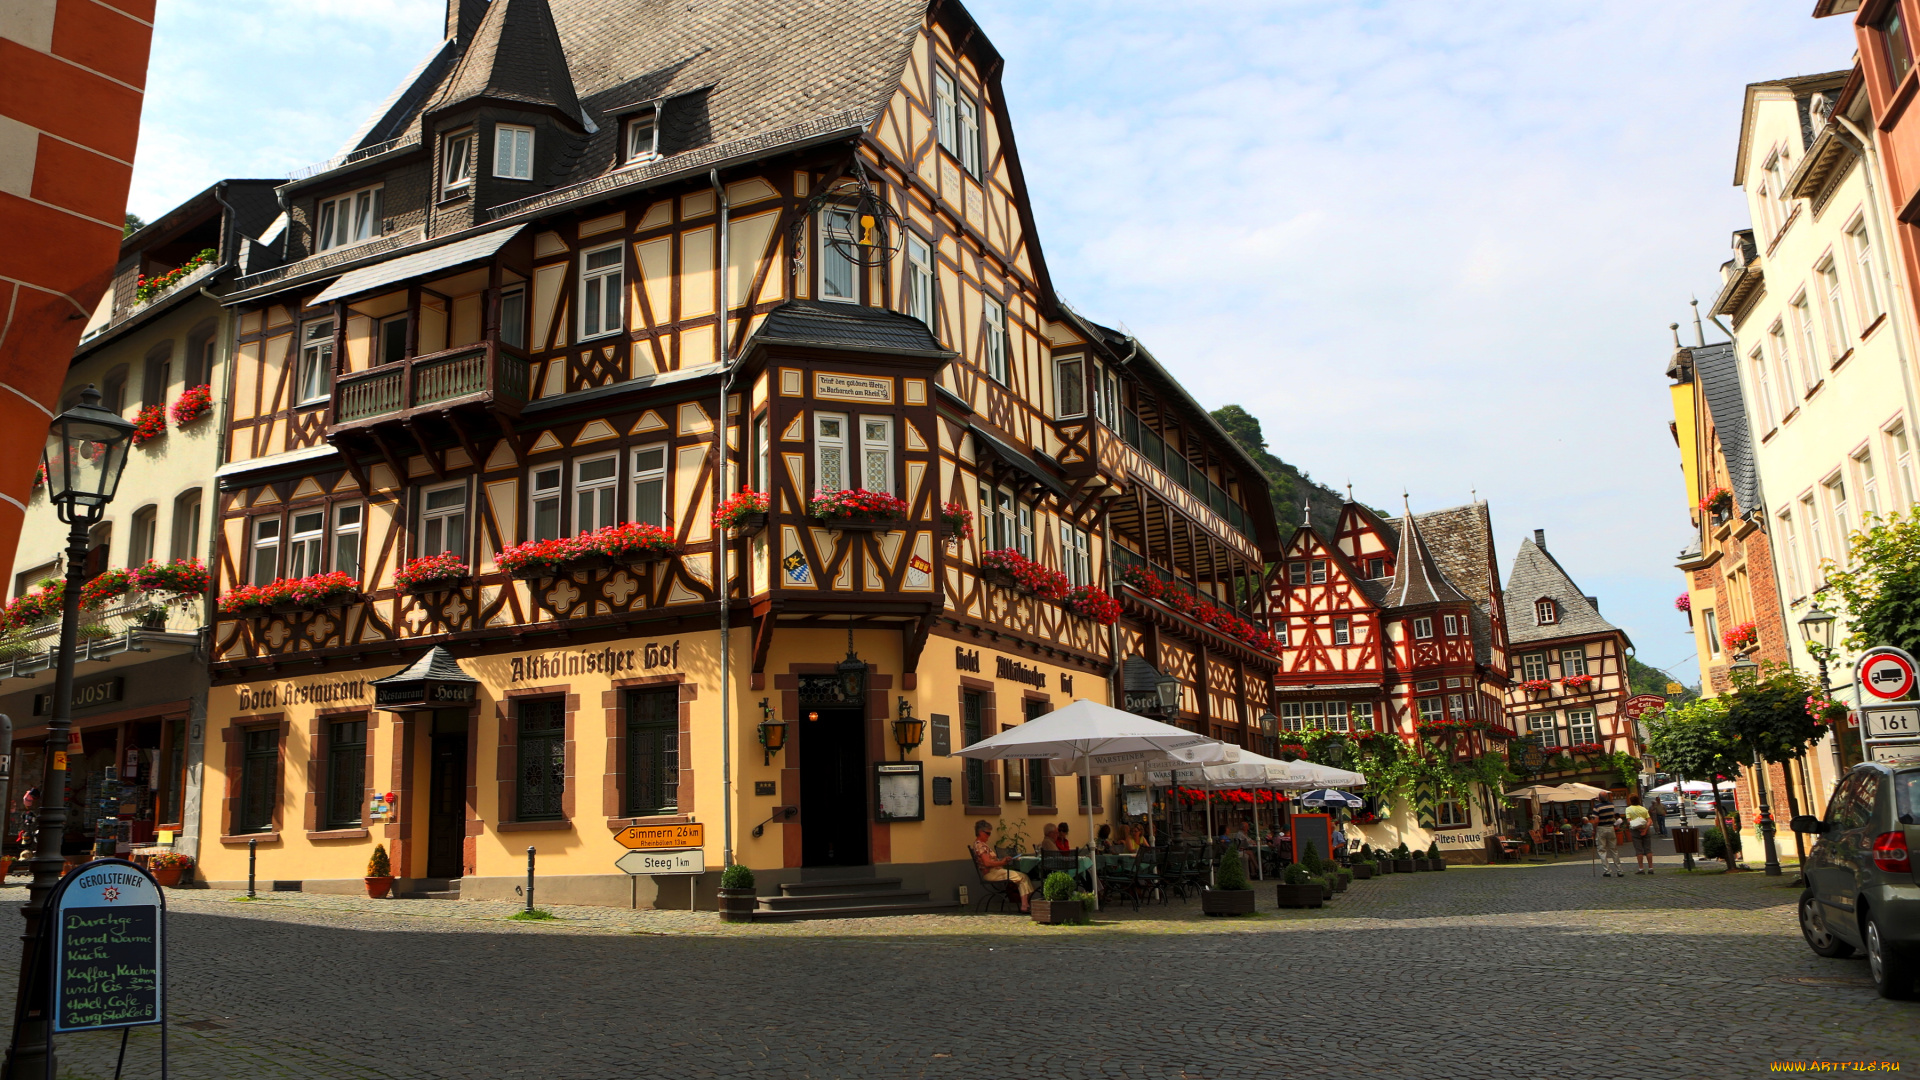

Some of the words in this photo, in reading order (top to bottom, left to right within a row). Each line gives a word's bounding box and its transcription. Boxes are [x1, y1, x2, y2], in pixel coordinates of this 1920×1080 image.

[511, 646, 634, 682] Altkölnischer
[644, 640, 680, 670] Hof
[77, 682, 113, 705] JOST
[240, 684, 278, 711] Hotel
[282, 678, 365, 706] Restaurant
[434, 684, 468, 701] Hotel
[1124, 694, 1158, 710] Hotel
[1094, 752, 1145, 764] WARSTEINER
[629, 828, 672, 839] Simmern
[1434, 834, 1456, 844] Altes
[644, 857, 672, 870] Steeg
[79, 872, 143, 889] GEROLSTEINER
[66, 982, 98, 994] und
